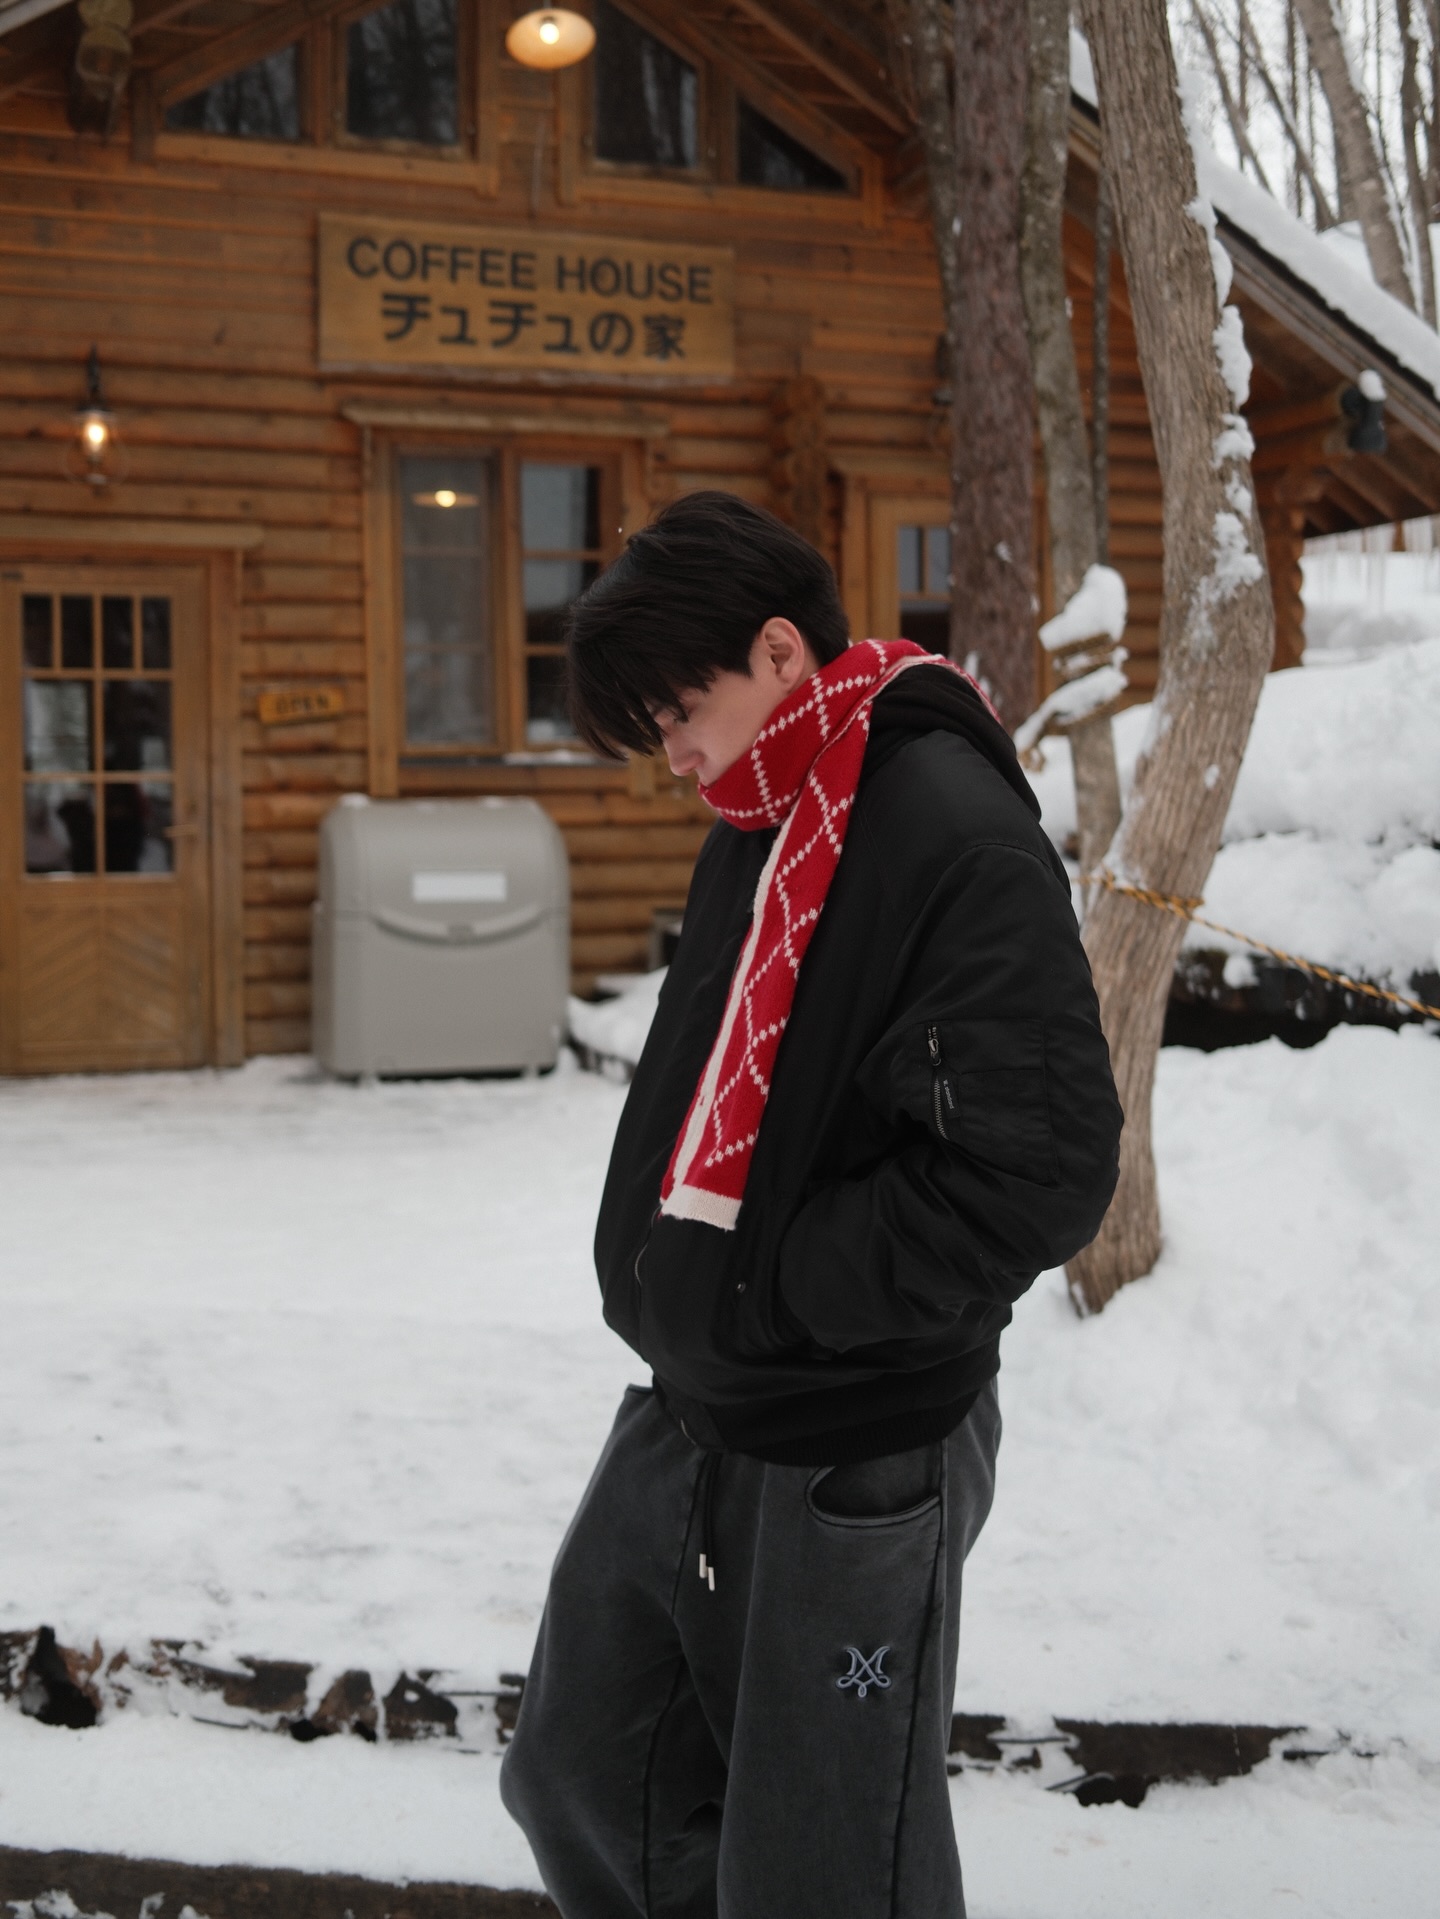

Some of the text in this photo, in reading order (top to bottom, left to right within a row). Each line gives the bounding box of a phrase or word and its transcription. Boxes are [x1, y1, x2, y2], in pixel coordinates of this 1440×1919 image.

[346, 237, 713, 305] COFFEE HOUSE
[381, 292, 686, 362] チュチュの家
